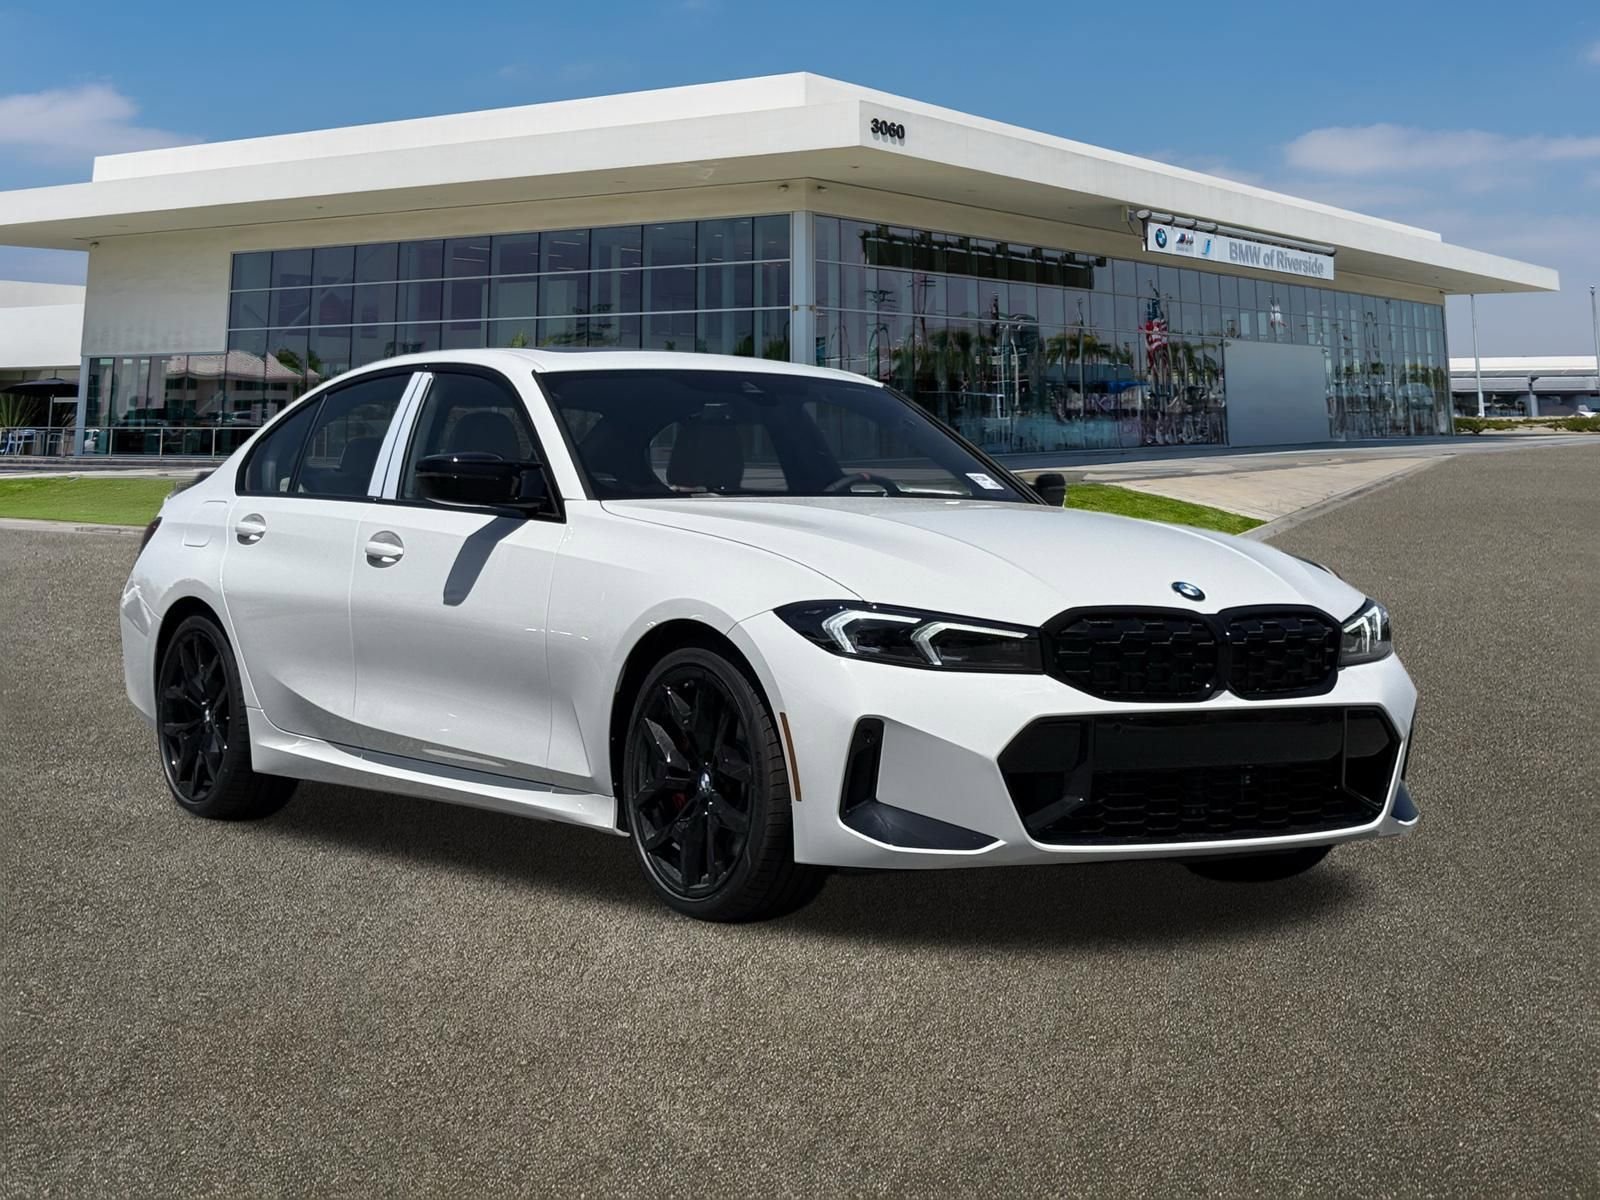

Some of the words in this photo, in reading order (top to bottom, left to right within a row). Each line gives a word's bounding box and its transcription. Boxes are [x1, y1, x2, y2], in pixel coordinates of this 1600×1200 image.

[871, 118, 905, 139] 3060
[1229, 241, 1261, 265] BMW
[1263, 249, 1275, 267] of
[1276, 251, 1325, 275] Riverside
